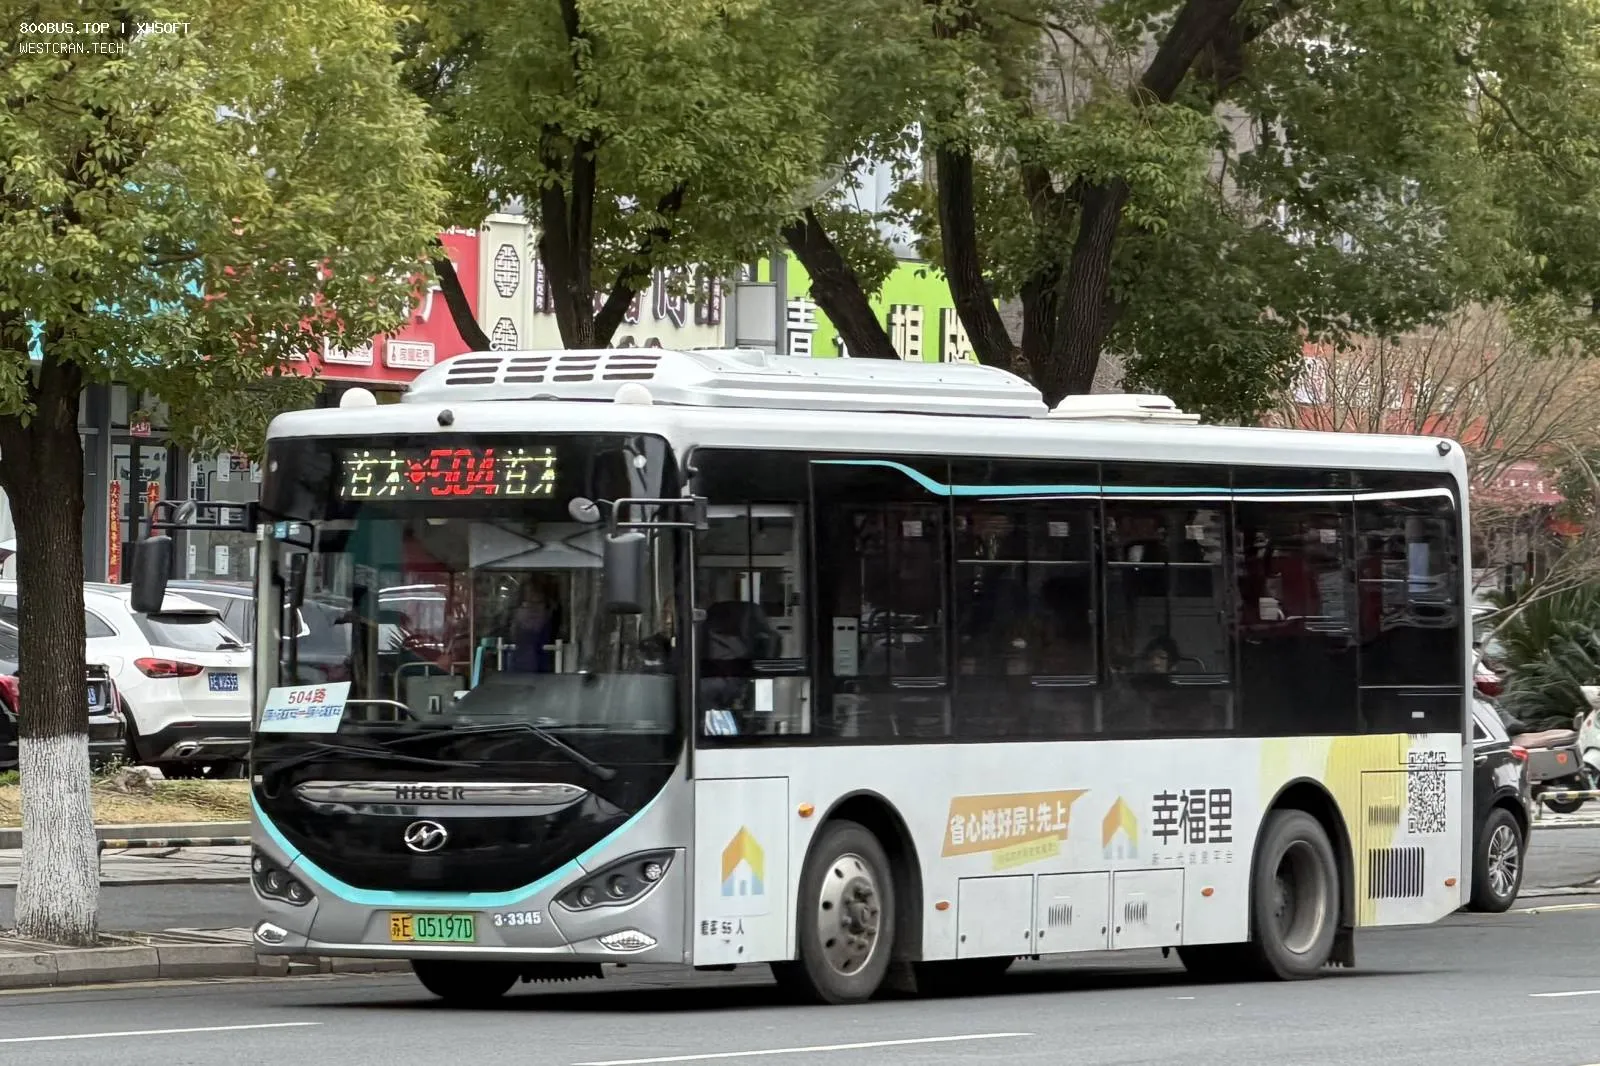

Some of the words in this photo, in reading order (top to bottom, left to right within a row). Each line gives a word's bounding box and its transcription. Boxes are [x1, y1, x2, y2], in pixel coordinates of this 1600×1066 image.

[429, 448, 494, 496] 504
[287, 688, 326, 704] 504路
[395, 785, 465, 800] HIGER
[1152, 788, 1233, 845] 幸福里
